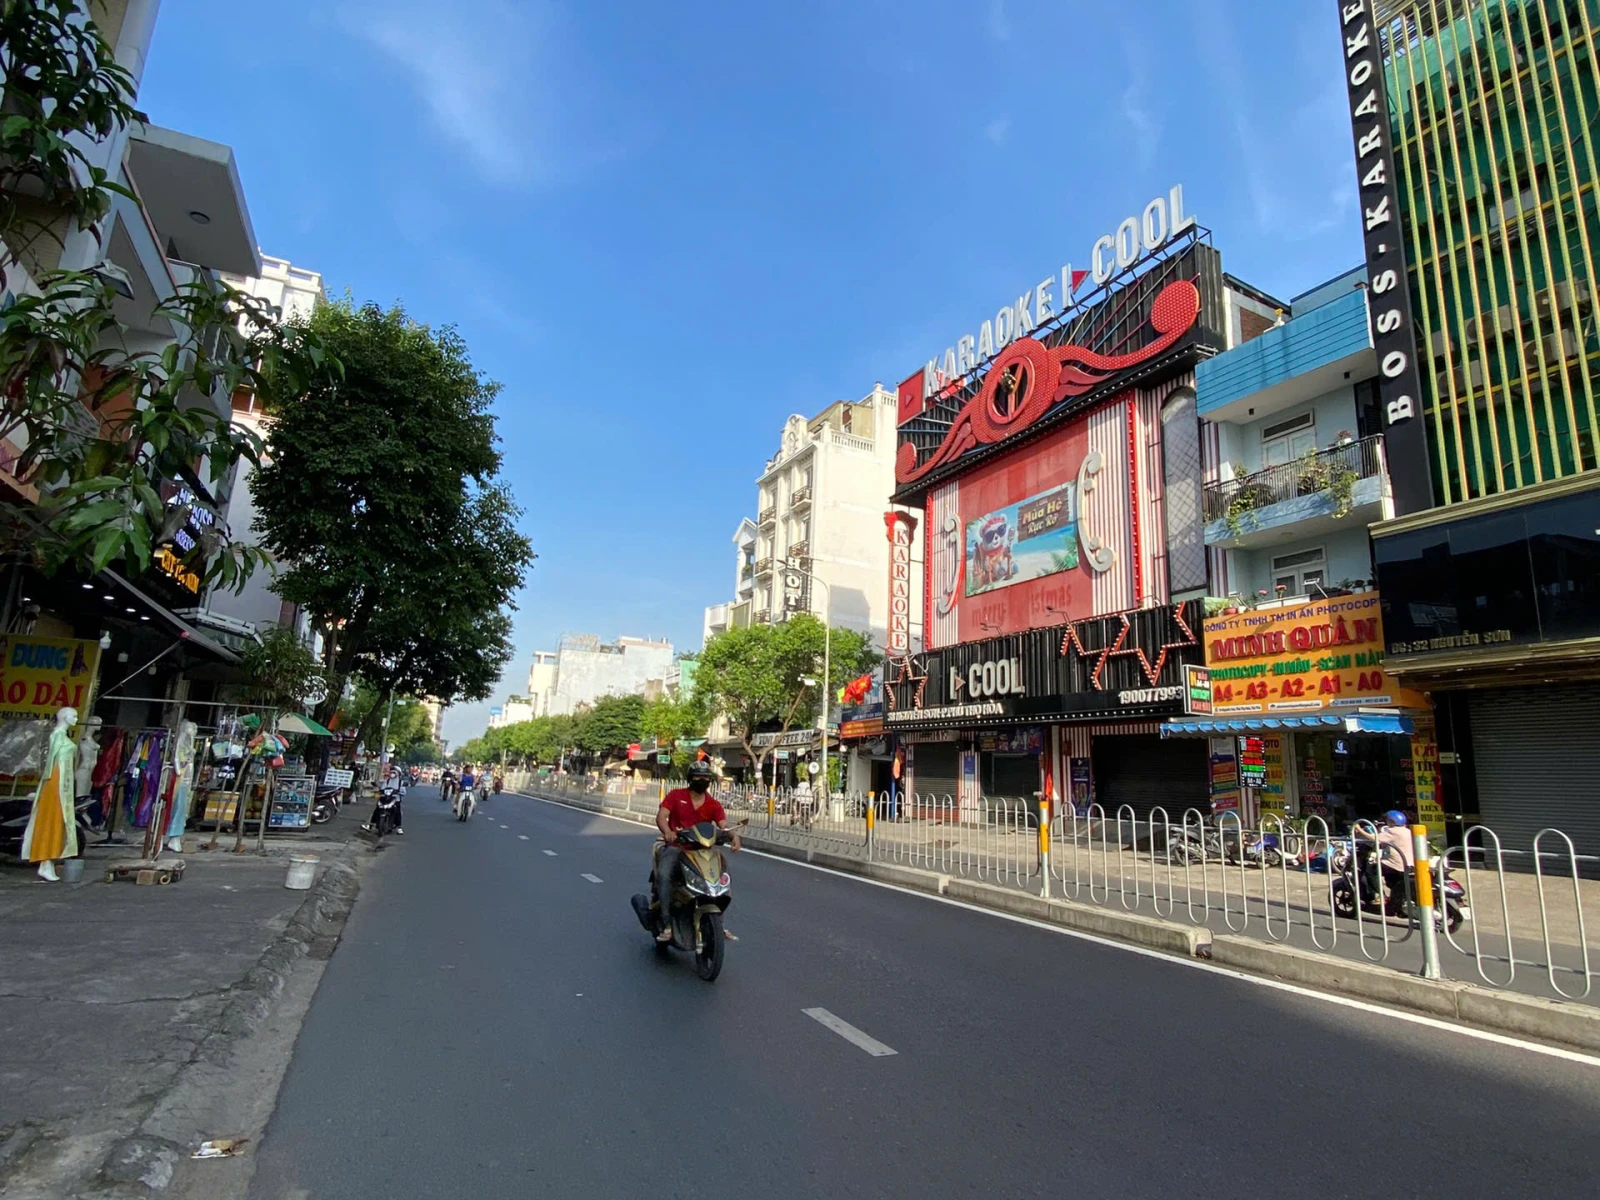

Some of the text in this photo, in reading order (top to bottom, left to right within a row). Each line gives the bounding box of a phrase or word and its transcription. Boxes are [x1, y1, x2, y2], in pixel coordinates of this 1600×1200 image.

[923, 274, 1056, 400] KARAOKE
[1091, 183, 1198, 286] COOL
[895, 529, 908, 648] KARAOKE
[1229, 619, 1241, 630] TY
[1243, 616, 1268, 626] TNHH
[1317, 597, 1380, 616] PHOTOCOP
[1213, 614, 1379, 661] MINH QUÂN
[31, 677, 84, 708] DÀI
[968, 656, 1025, 698] COOL
[1214, 683, 1234, 703] A4
[1246, 680, 1270, 701] A3
[1280, 677, 1305, 699] A2
[1318, 674, 1342, 696] A1
[1357, 670, 1383, 692] A0
